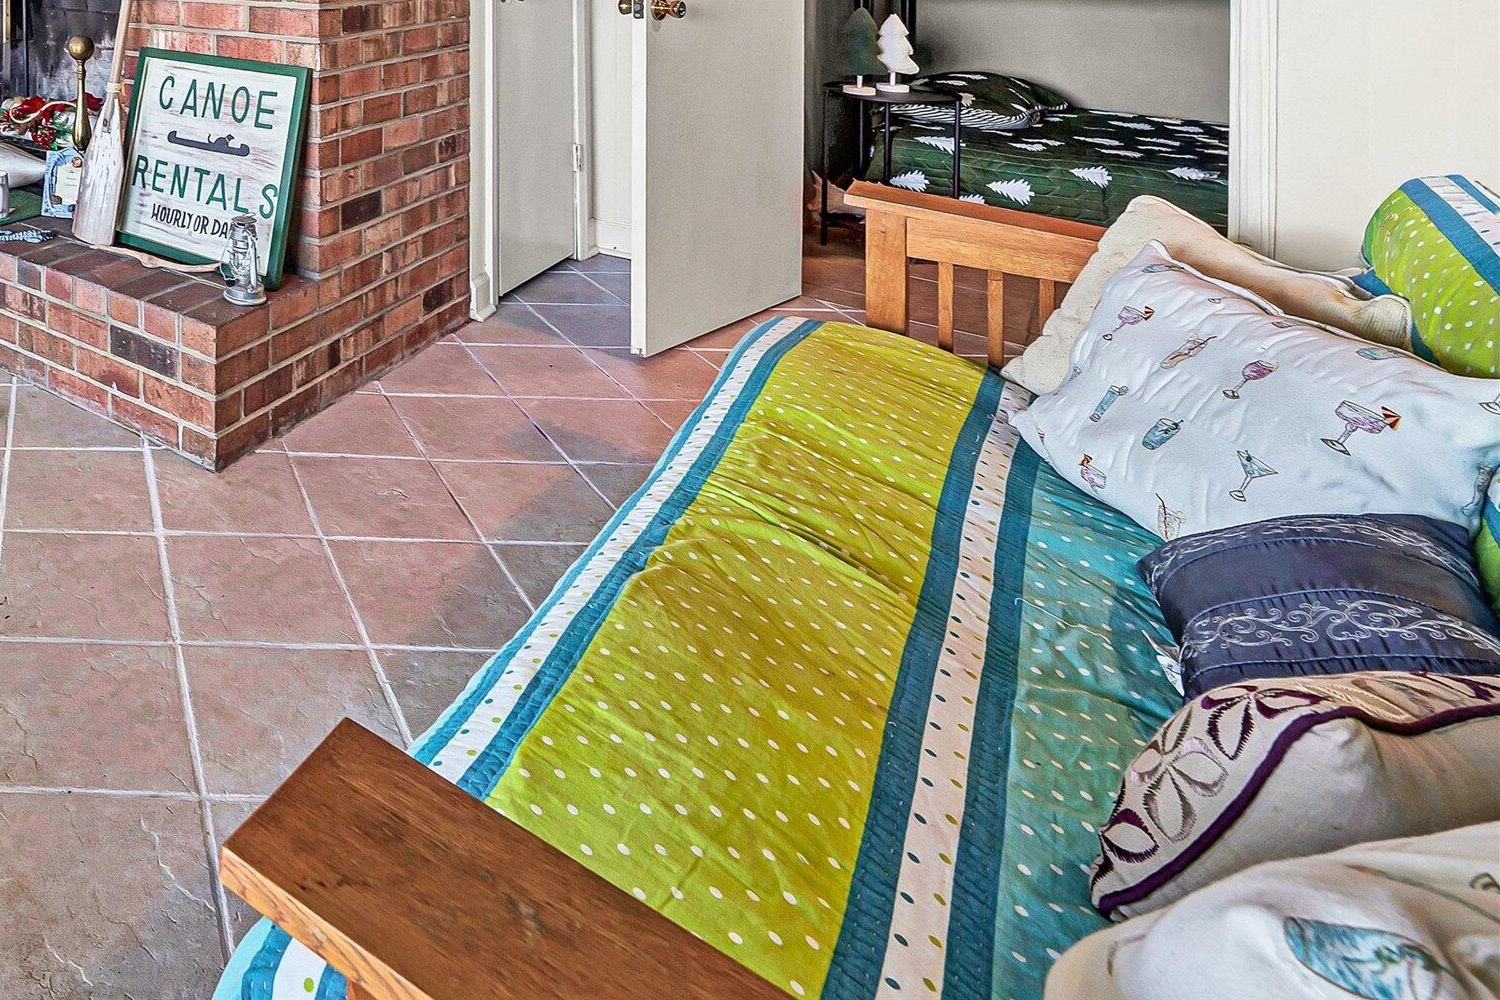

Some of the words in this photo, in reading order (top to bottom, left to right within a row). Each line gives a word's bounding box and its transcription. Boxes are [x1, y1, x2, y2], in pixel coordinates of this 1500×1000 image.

[158, 75, 278, 130] CANOE
[132, 154, 278, 220] RENTALS
[151, 203, 194, 230] HOURLY
[193, 214, 208, 235] OR
